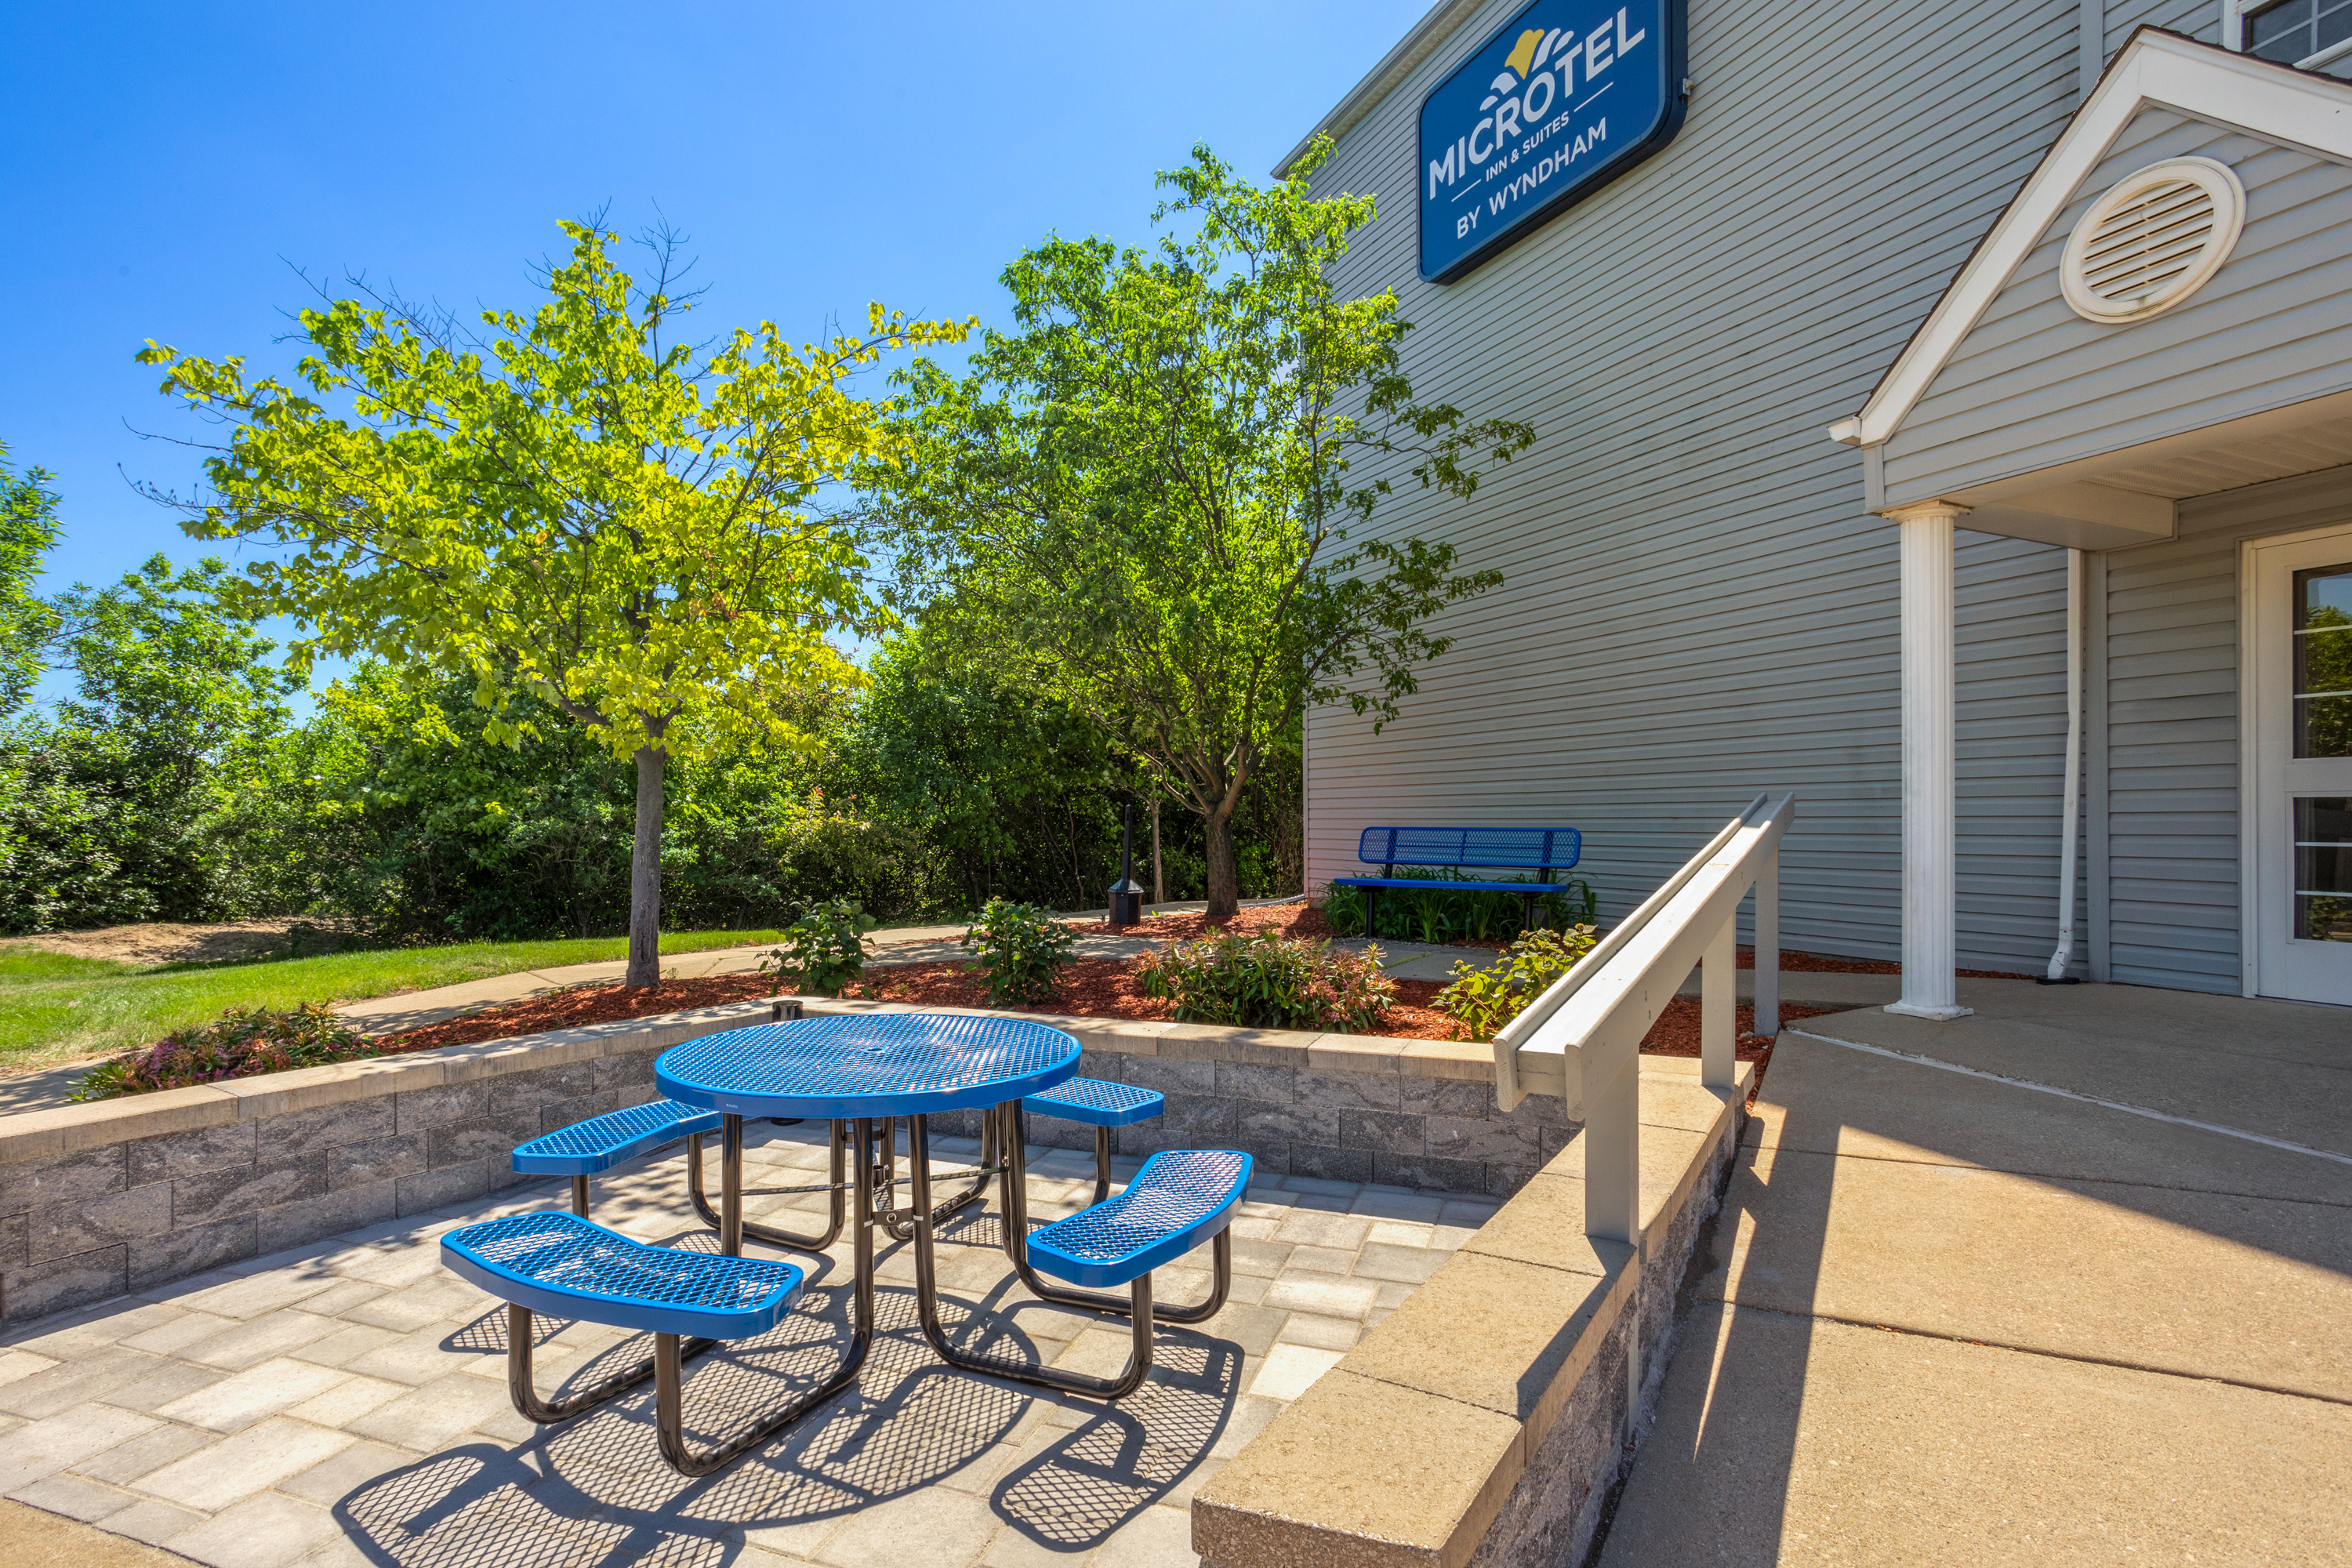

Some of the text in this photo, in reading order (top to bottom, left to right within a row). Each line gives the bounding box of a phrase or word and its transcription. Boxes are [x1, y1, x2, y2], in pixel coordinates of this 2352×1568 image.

[1429, 6, 1645, 200] MICROTEL
[1486, 111, 1569, 182] INN & SUITES
[1457, 117, 1606, 239] BY WYNDHAM
